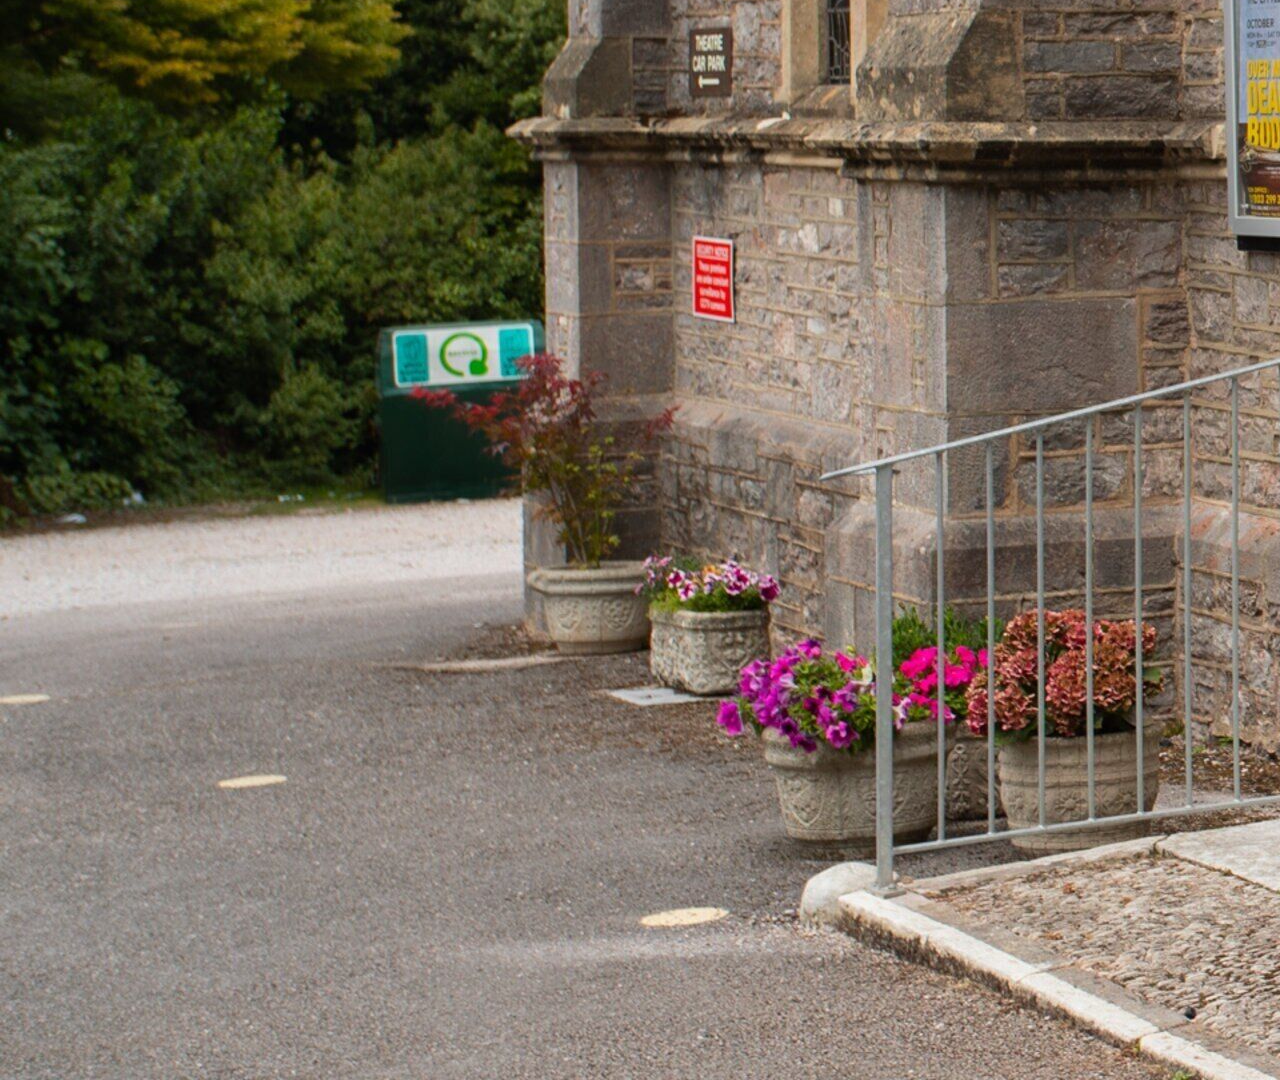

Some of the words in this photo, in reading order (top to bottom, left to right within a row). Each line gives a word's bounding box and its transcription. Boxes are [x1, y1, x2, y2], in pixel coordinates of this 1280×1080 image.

[1247, 18, 1275, 29] OCTOBER
[695, 34, 723, 51] THEATRE
[693, 55, 706, 72] CAR
[707, 55, 726, 72] PARK
[1246, 59, 1270, 79] OVER
[1266, 194, 1277, 204] 299
